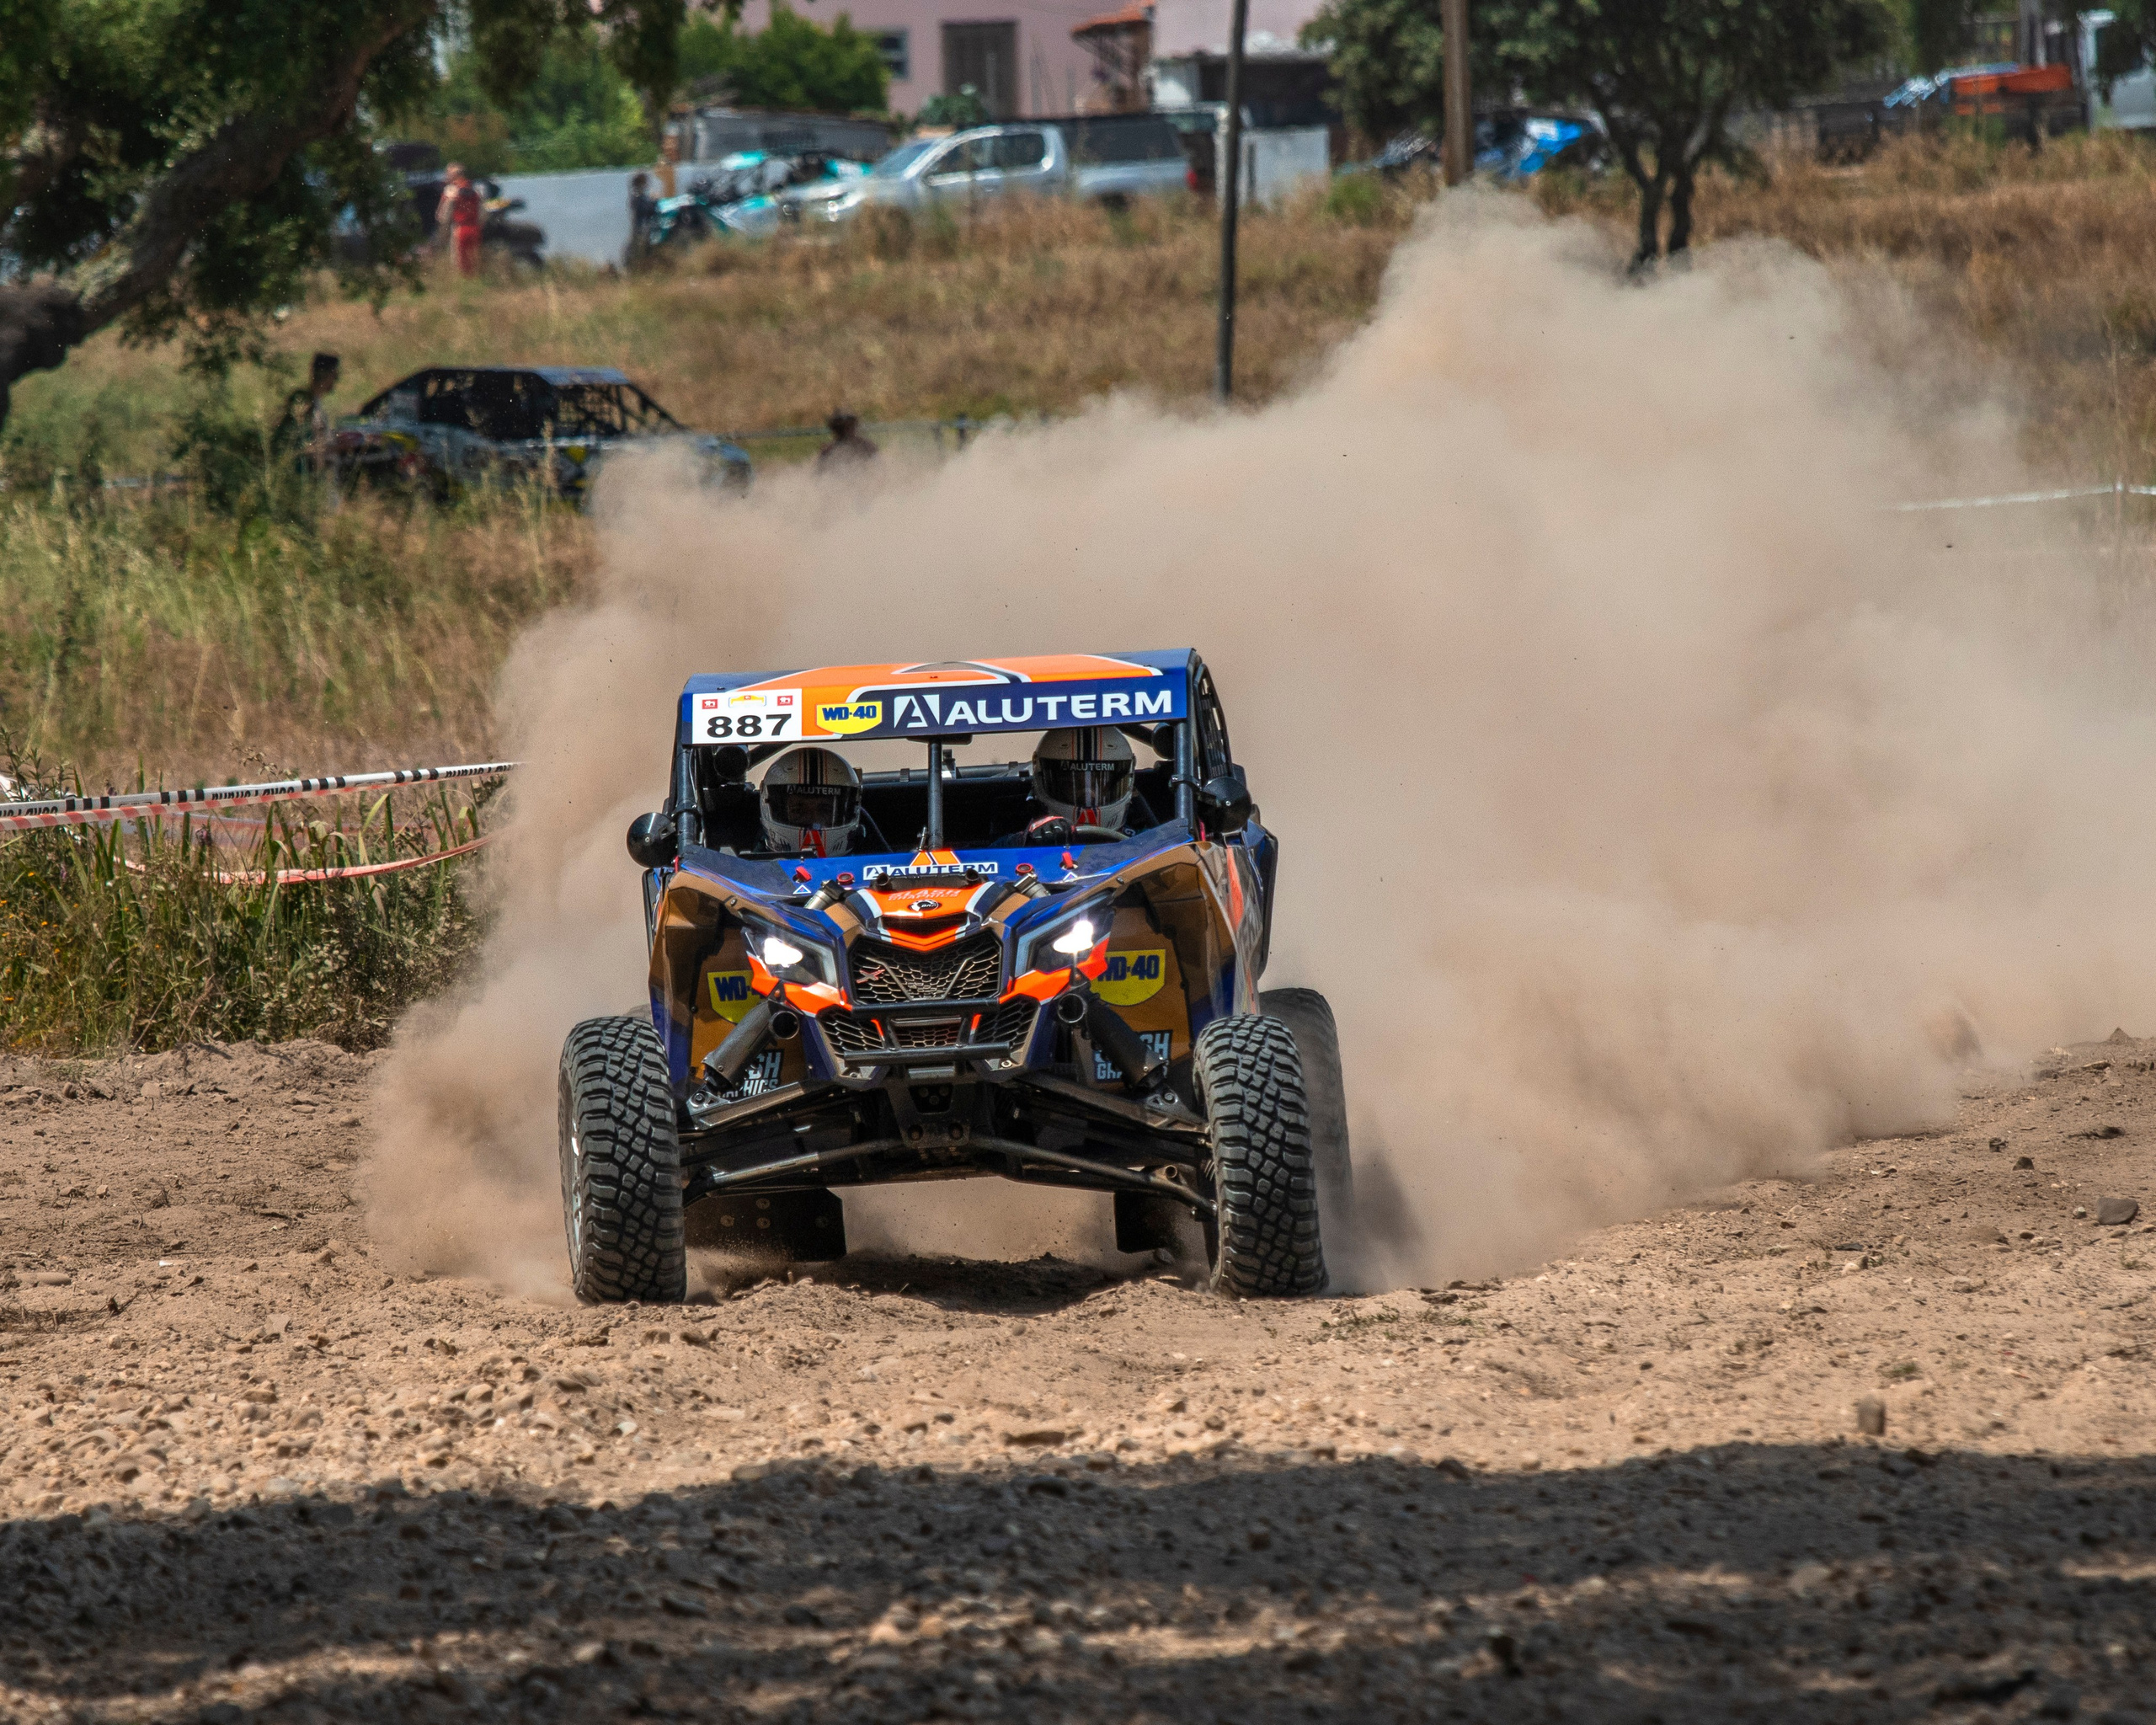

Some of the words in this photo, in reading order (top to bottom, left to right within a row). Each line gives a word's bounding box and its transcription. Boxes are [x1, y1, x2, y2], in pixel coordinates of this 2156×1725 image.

[822, 705, 877, 721] WD-40
[944, 690, 1172, 726] ALUTERM
[707, 713, 792, 738] 887
[796, 786, 841, 796] ALUTERM
[890, 863, 995, 876] ALUTERM
